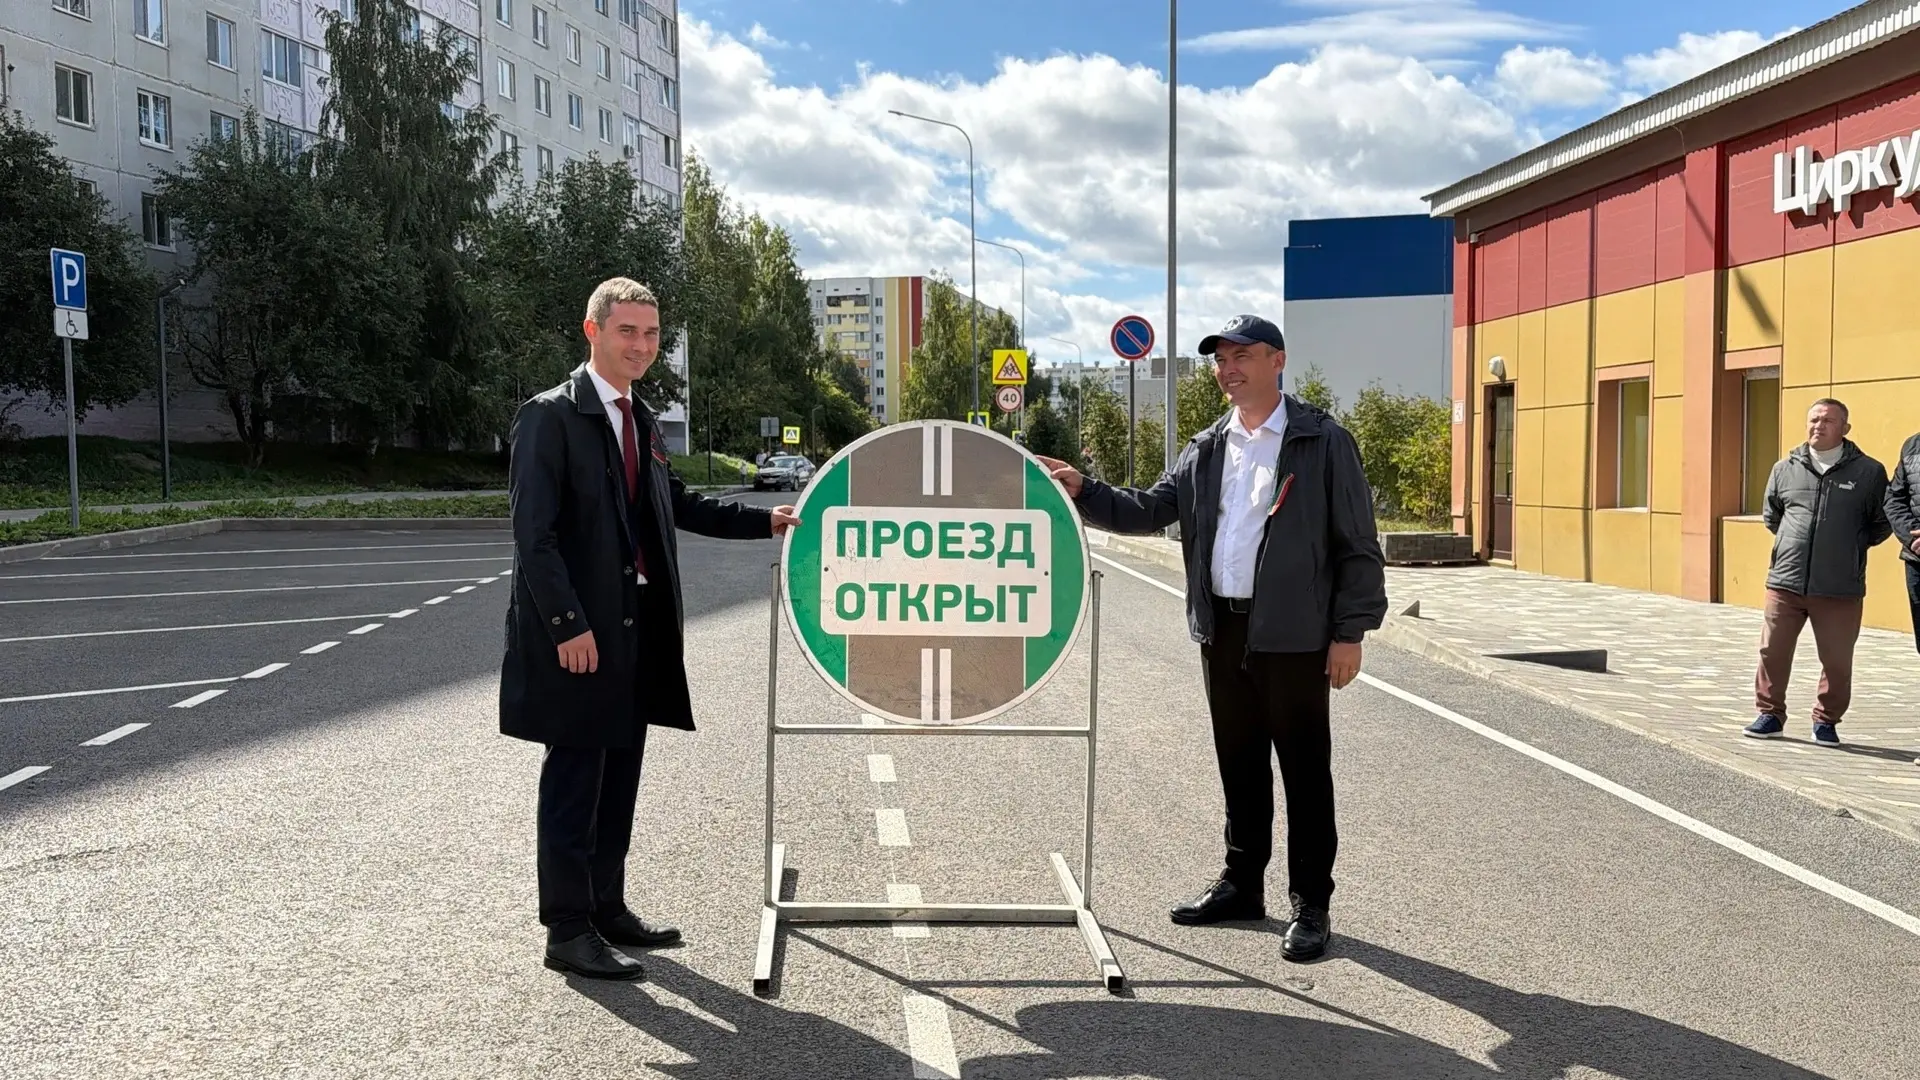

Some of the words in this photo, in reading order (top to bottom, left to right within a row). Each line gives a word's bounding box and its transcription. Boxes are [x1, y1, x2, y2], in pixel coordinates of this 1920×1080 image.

[1774, 129, 1920, 216] Цирку
[61, 257, 80, 301] P
[1002, 393, 1017, 403] 40
[836, 520, 1035, 568] ПРОЕЗД
[835, 582, 1037, 623] ОТКРЫТ
